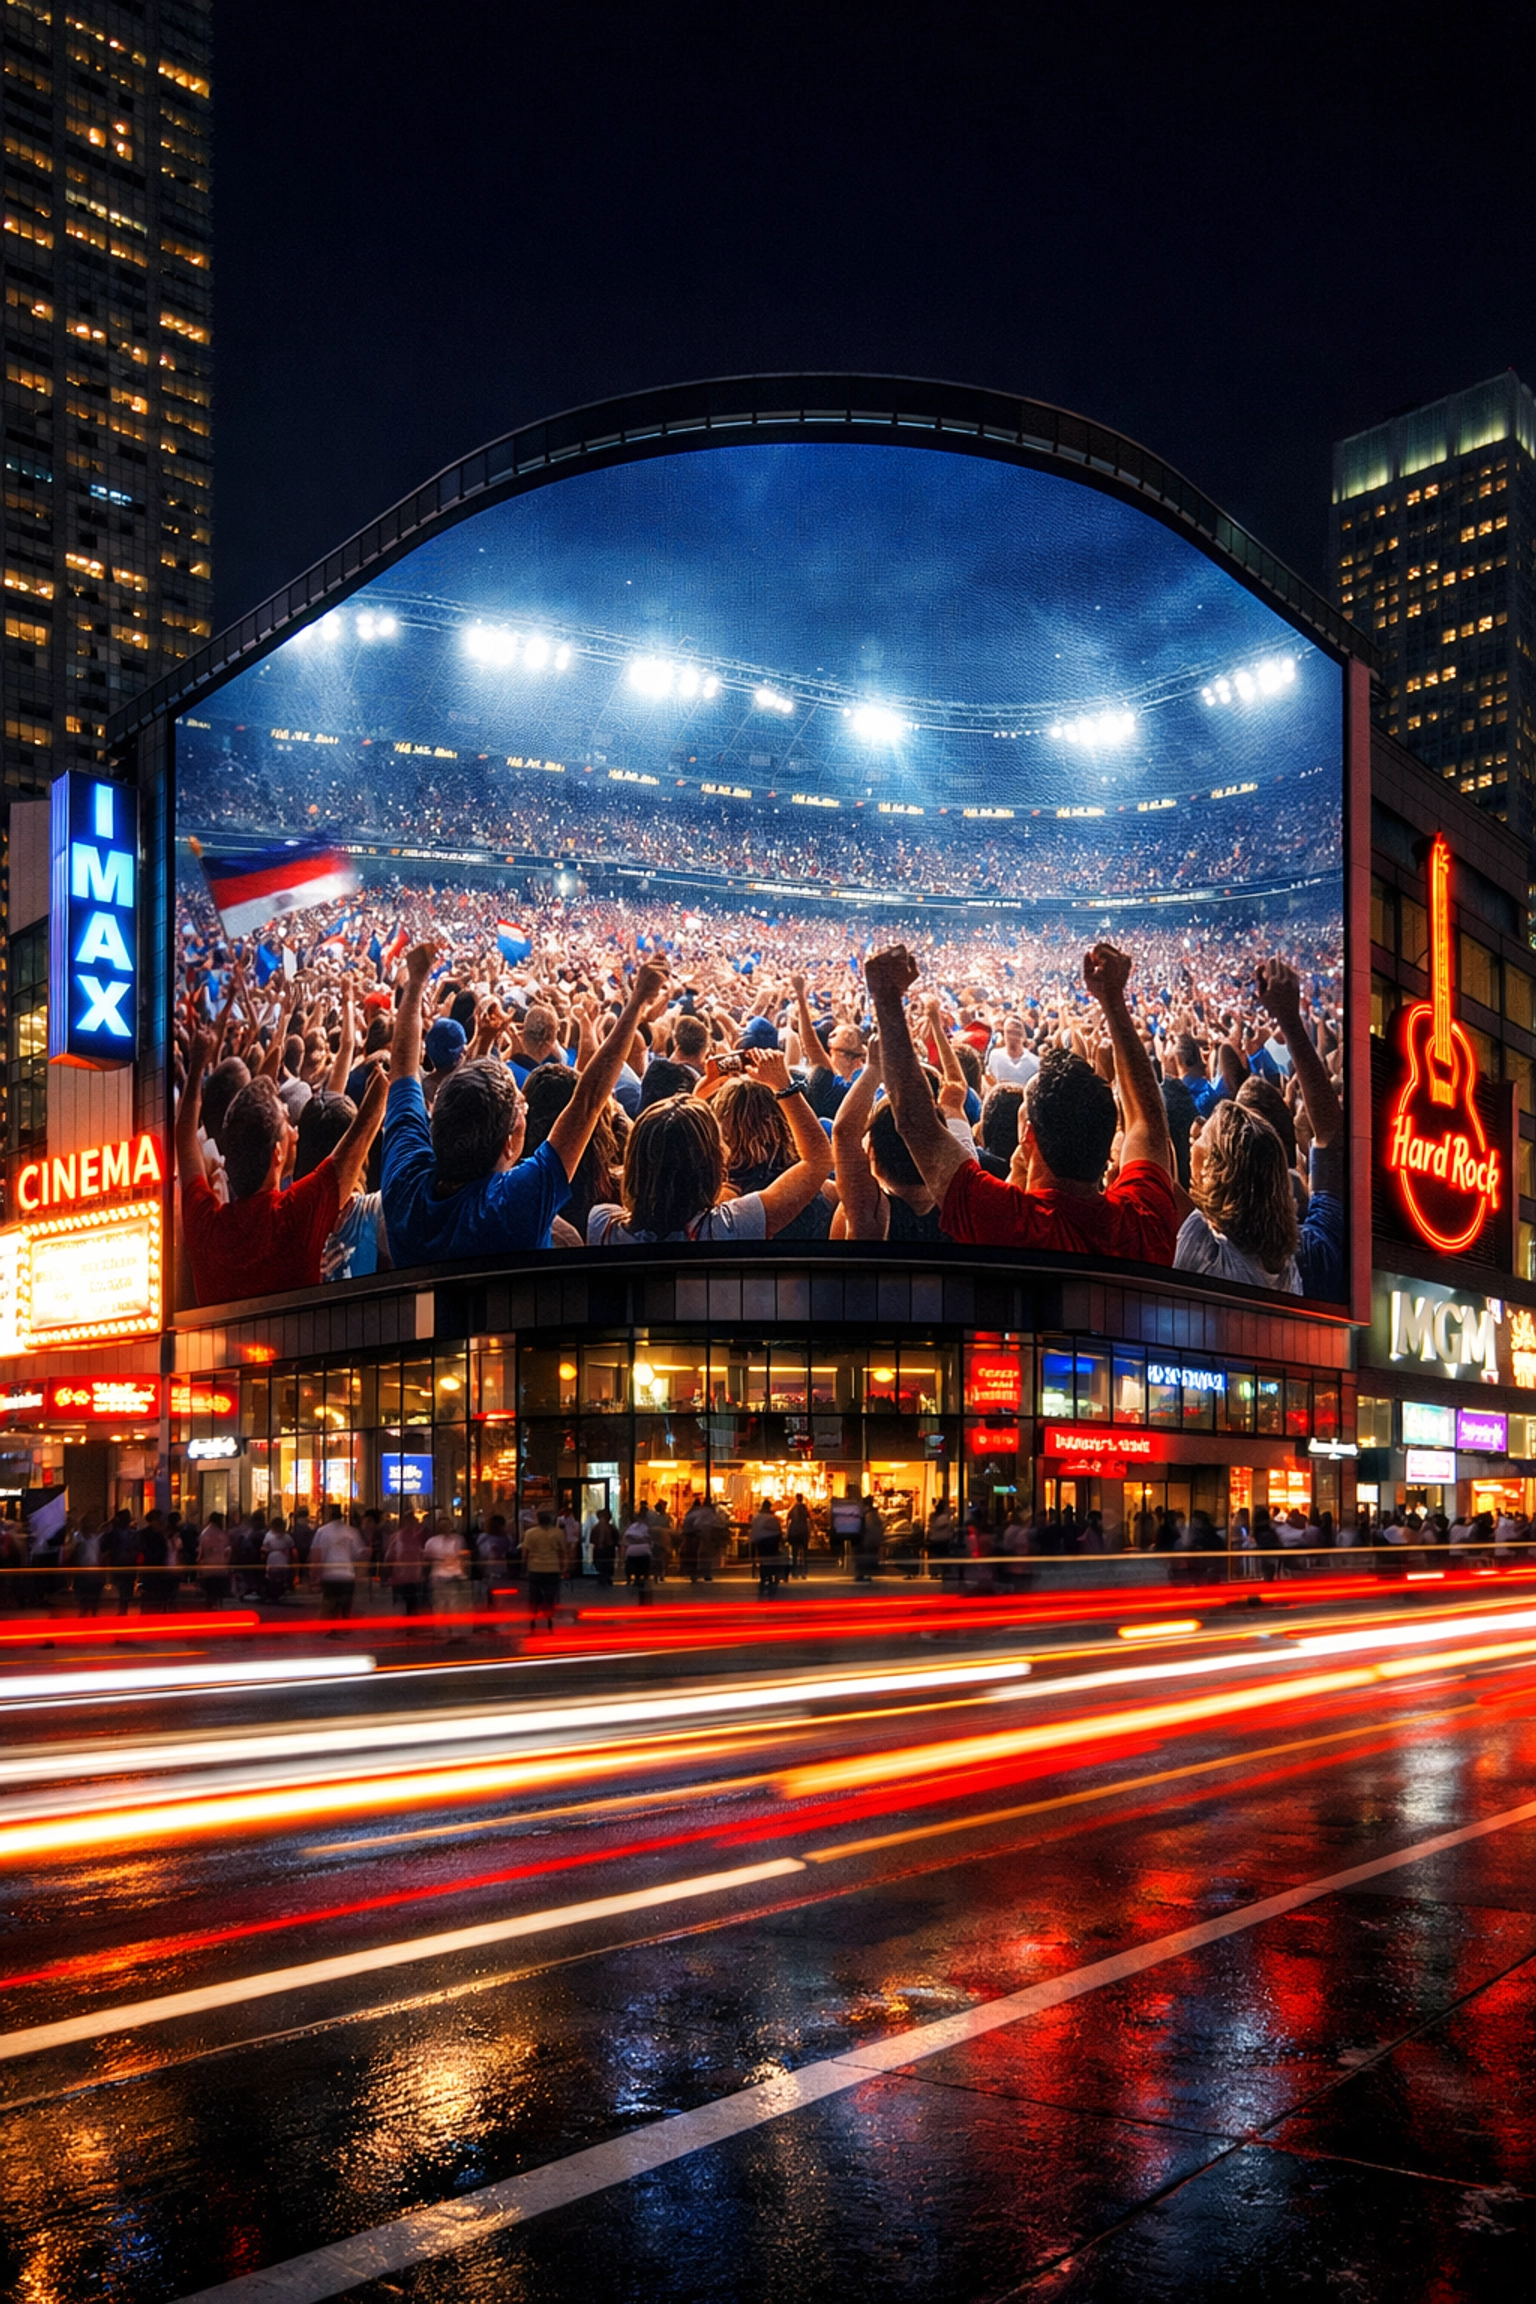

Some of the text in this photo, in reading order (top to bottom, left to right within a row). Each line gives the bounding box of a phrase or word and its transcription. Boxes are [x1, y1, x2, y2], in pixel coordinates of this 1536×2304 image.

[72, 783, 134, 1037] IMAX
[17, 1134, 161, 1210] CINEMA
[1392, 1115, 1499, 1209] Hard Rock
[1390, 1290, 1498, 1378] MGM
